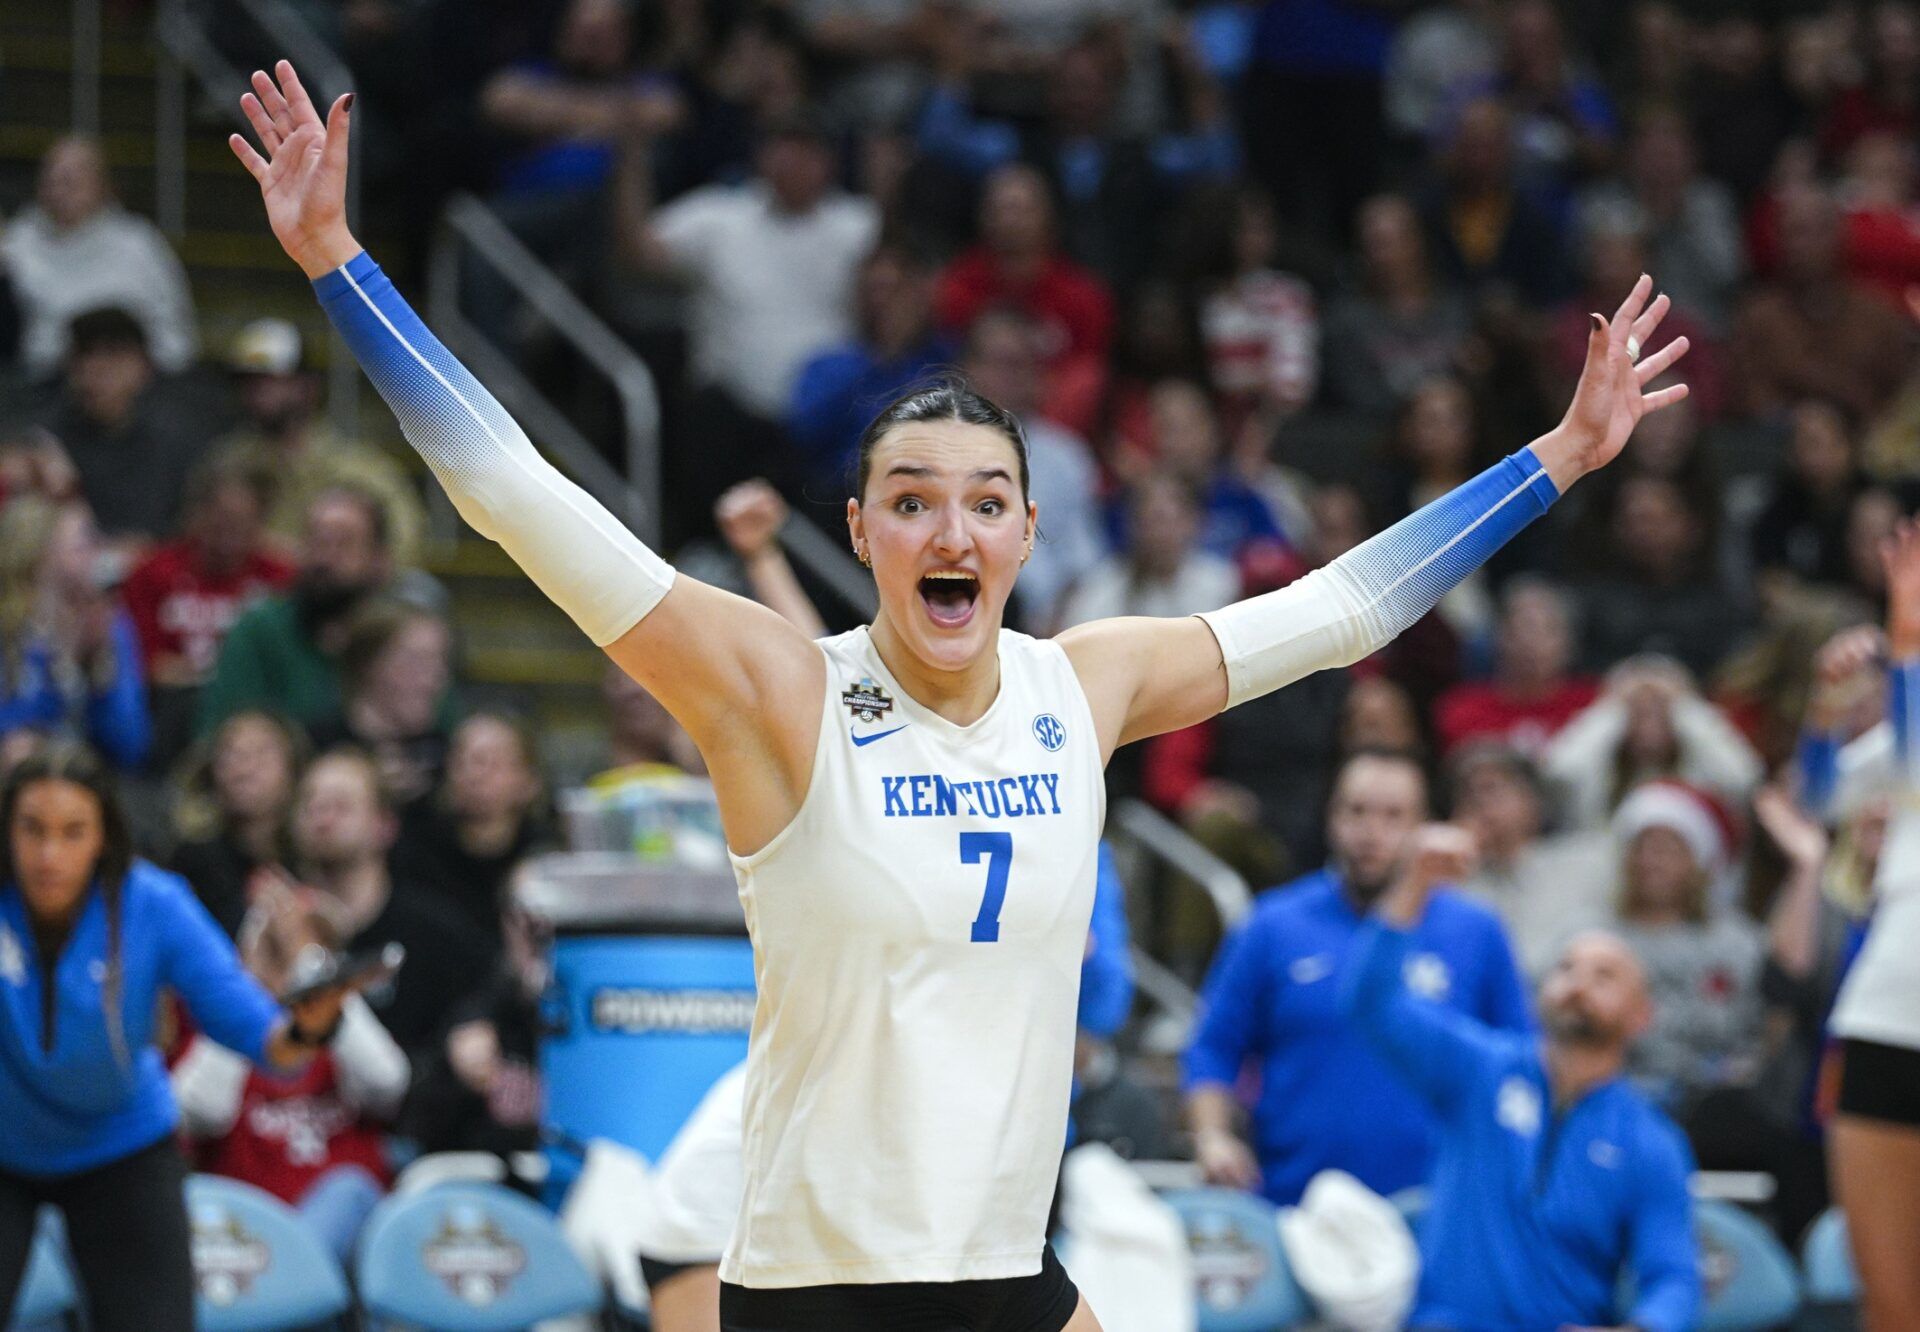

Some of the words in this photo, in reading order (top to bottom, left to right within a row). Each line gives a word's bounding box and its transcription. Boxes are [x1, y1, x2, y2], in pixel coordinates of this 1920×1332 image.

[1035, 716, 1063, 749] SEC
[881, 773, 1062, 818] KENTUCKY
[959, 832, 1013, 943] 7
